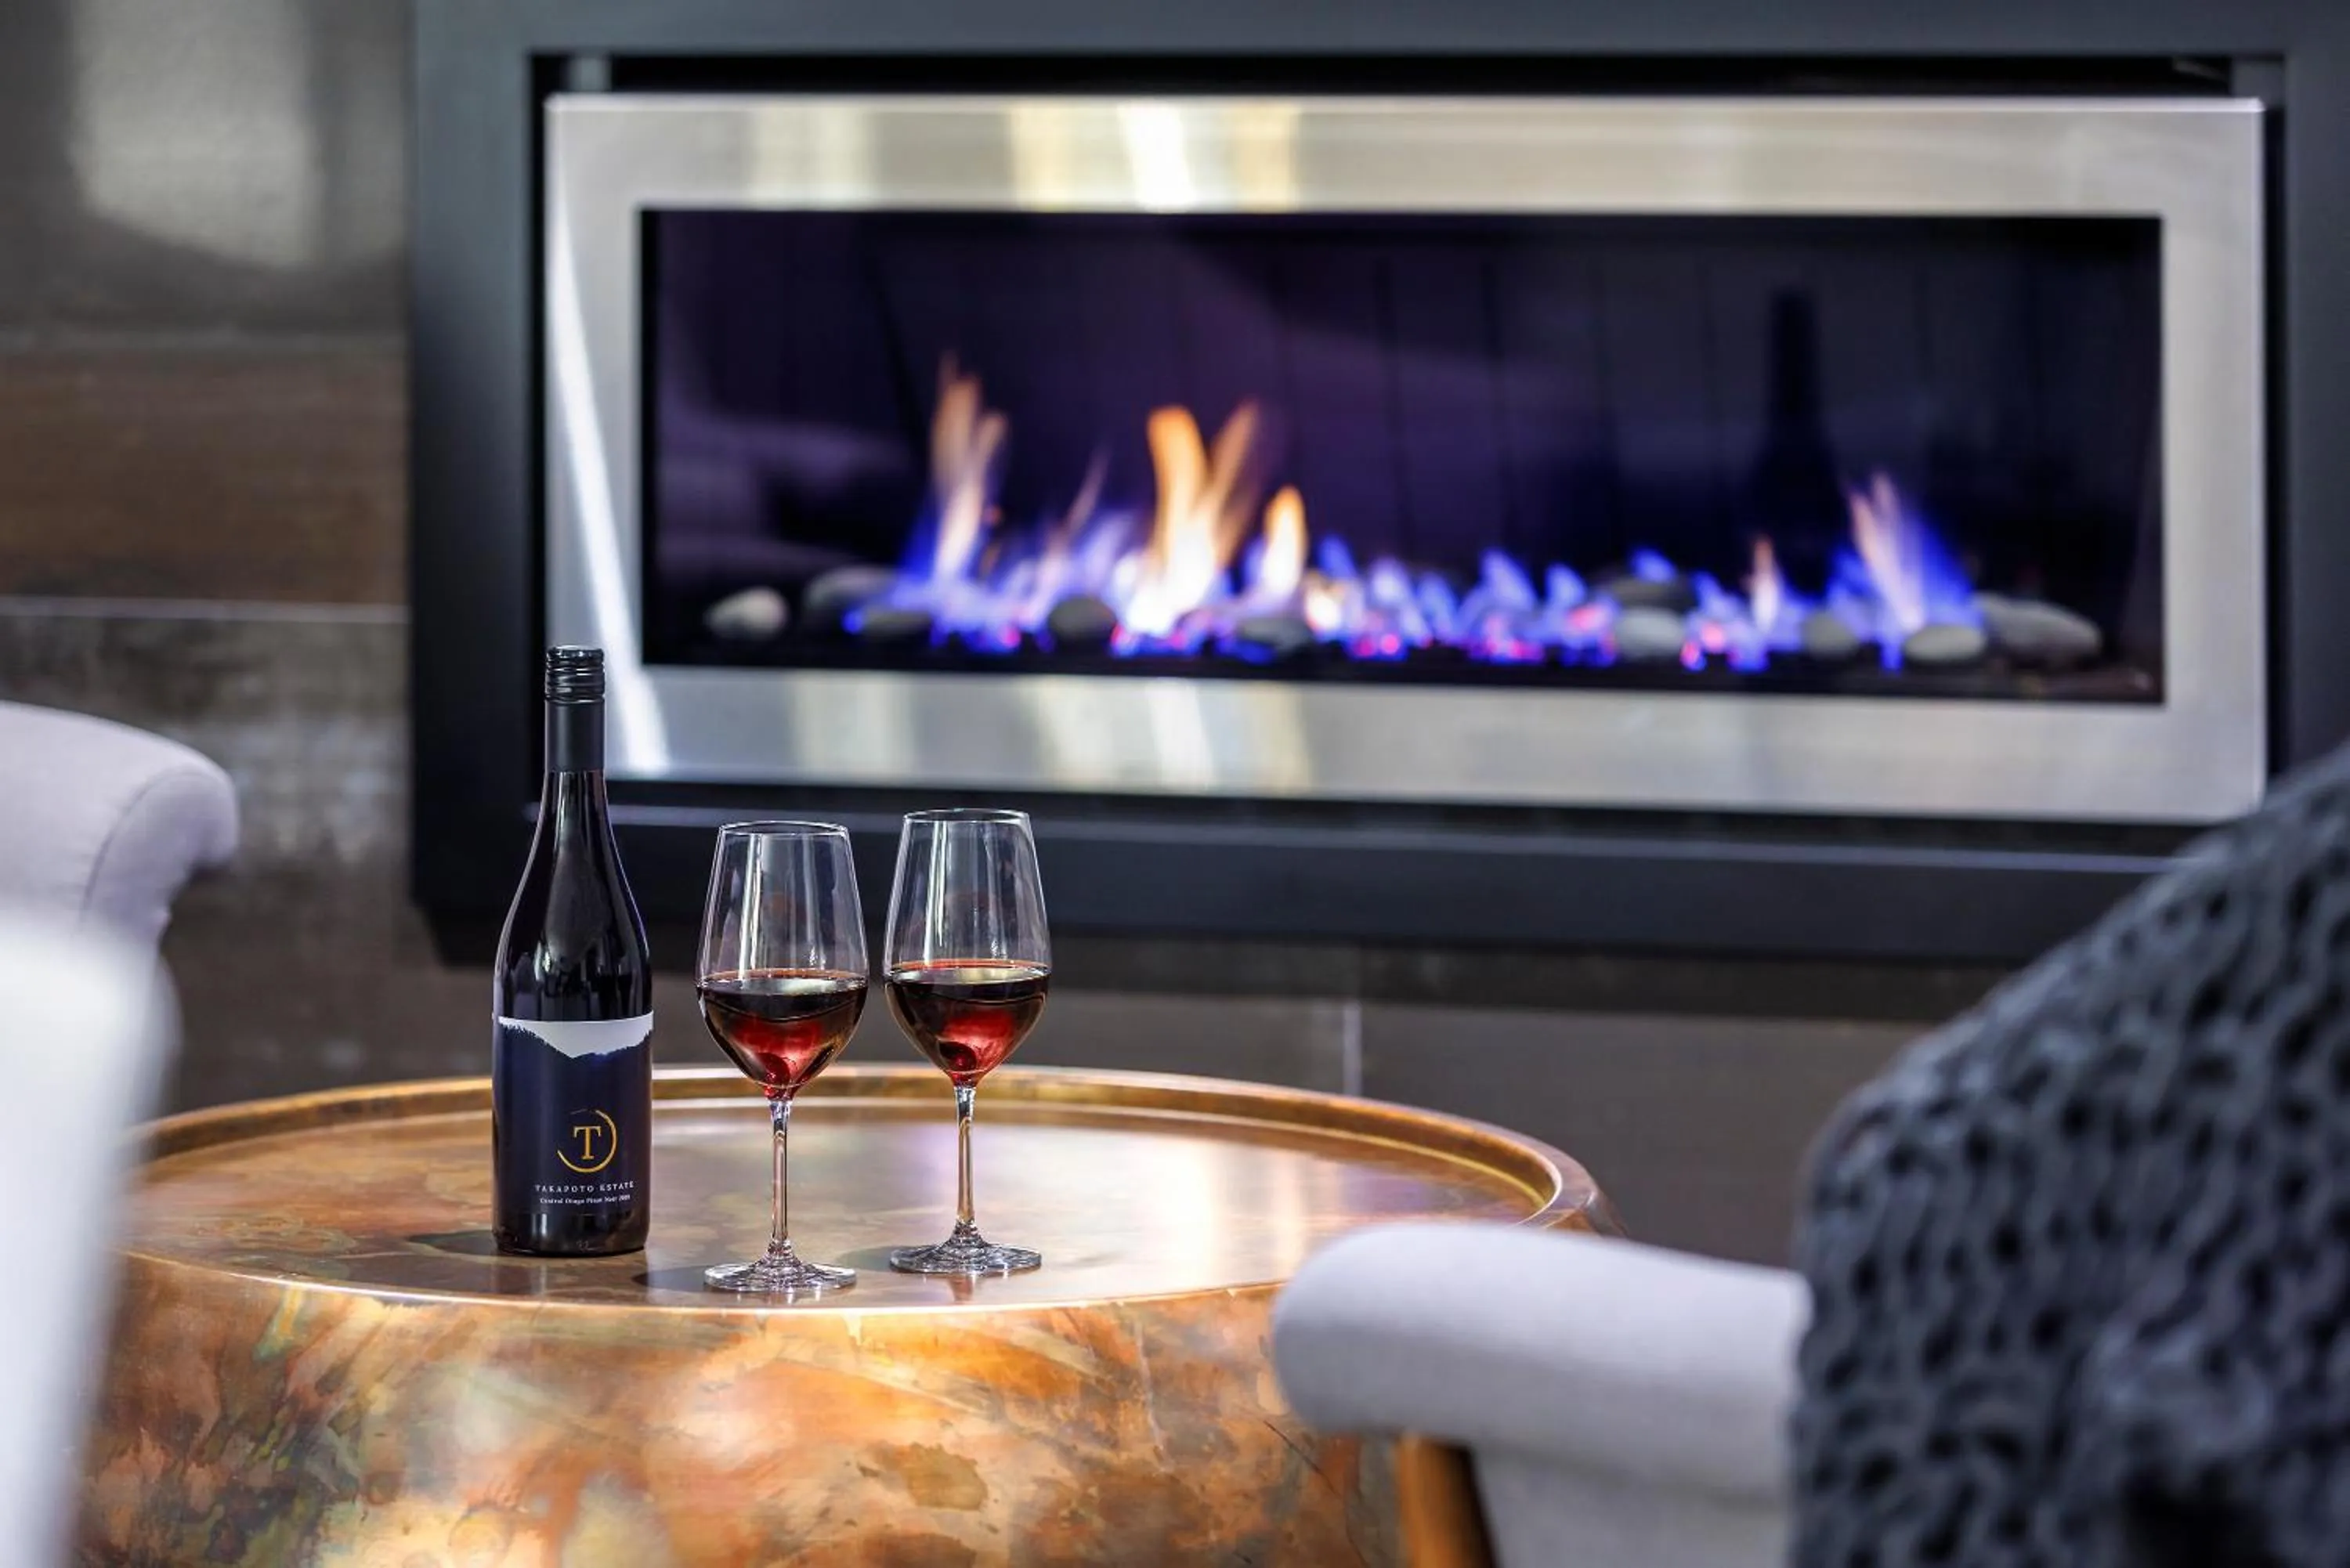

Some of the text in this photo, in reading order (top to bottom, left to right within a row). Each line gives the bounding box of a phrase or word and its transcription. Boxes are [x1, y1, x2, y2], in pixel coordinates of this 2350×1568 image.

[573, 1125, 602, 1160] T
[535, 1180, 634, 1193] TAKAPOTO ESTATE
